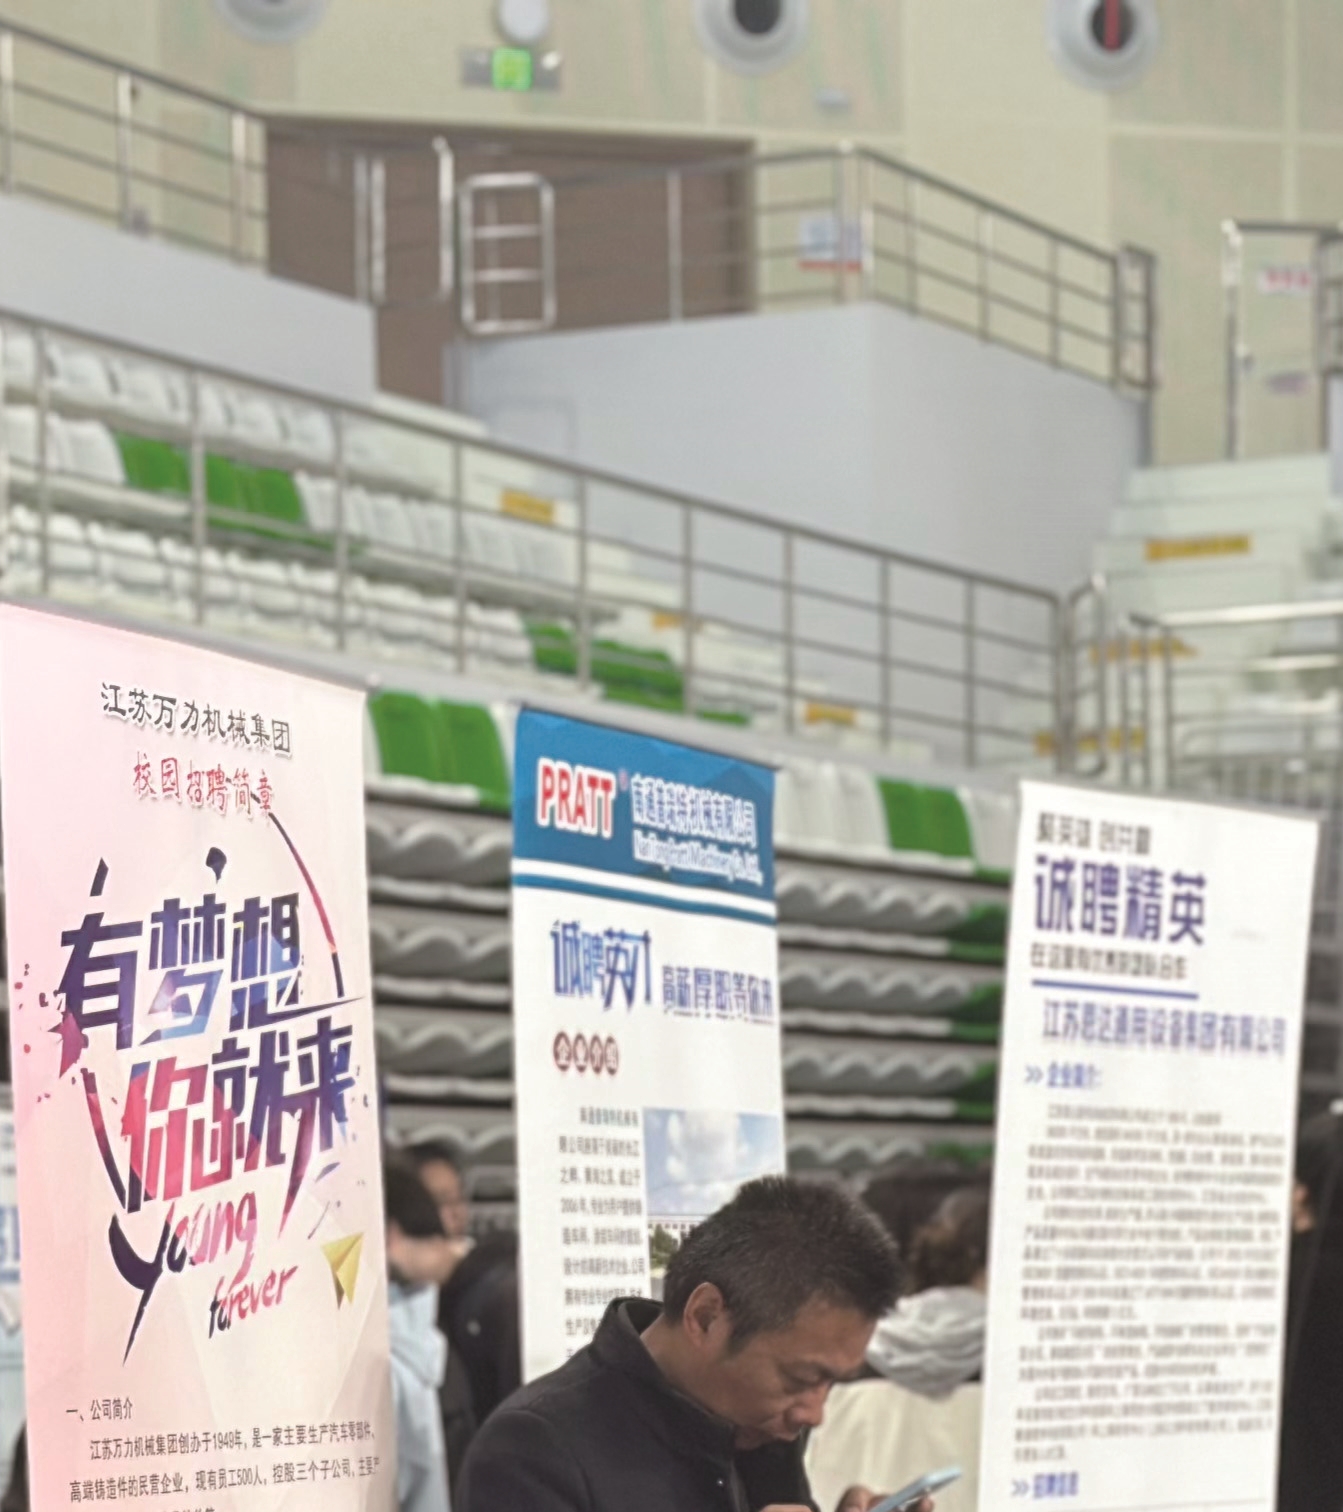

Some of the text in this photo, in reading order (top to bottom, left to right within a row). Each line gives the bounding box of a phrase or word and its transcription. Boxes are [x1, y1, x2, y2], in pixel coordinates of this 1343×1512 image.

[101, 682, 292, 754] 江苏万力机械集团
[133, 752, 273, 811] 校园招聘简章
[537, 758, 616, 838] PRATT
[1035, 853, 1207, 946] 诚聘精英
[48, 847, 303, 1050] 有梦想
[208, 1264, 299, 1339] forever
